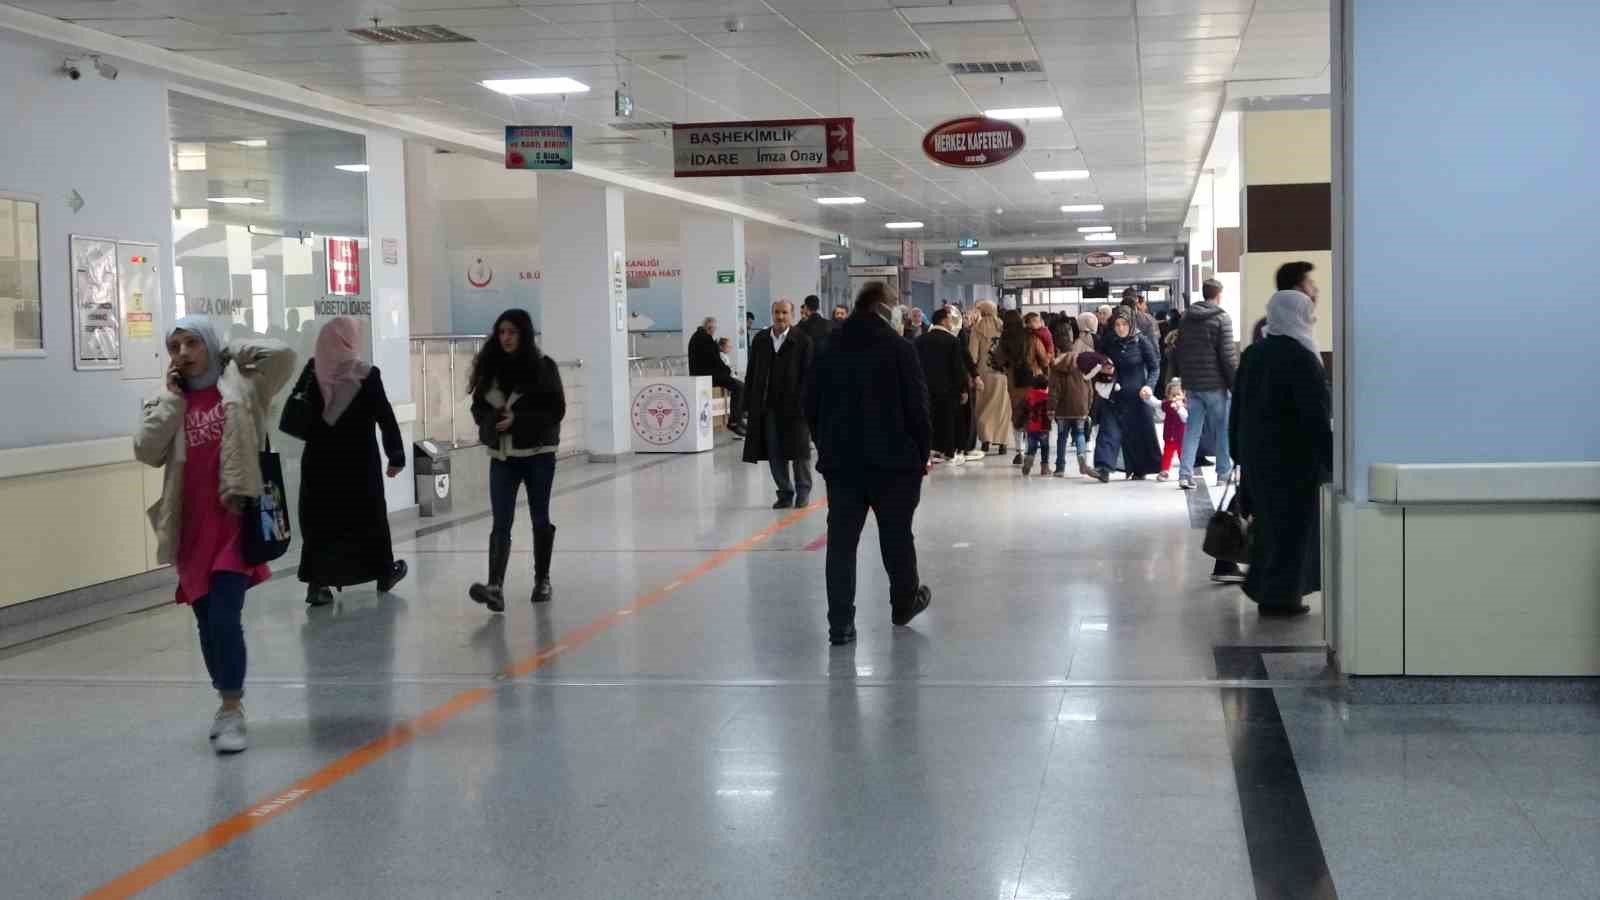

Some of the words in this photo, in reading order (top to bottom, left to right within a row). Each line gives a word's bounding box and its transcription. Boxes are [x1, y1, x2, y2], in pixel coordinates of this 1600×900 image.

[689, 128, 798, 145] BAŞHEKİMLİK
[934, 132, 966, 153] MERKEZ
[967, 130, 1013, 150] KAFETERYA
[690, 152, 739, 166] İDARE
[757, 147, 786, 163] İmza
[790, 150, 824, 164] Onay
